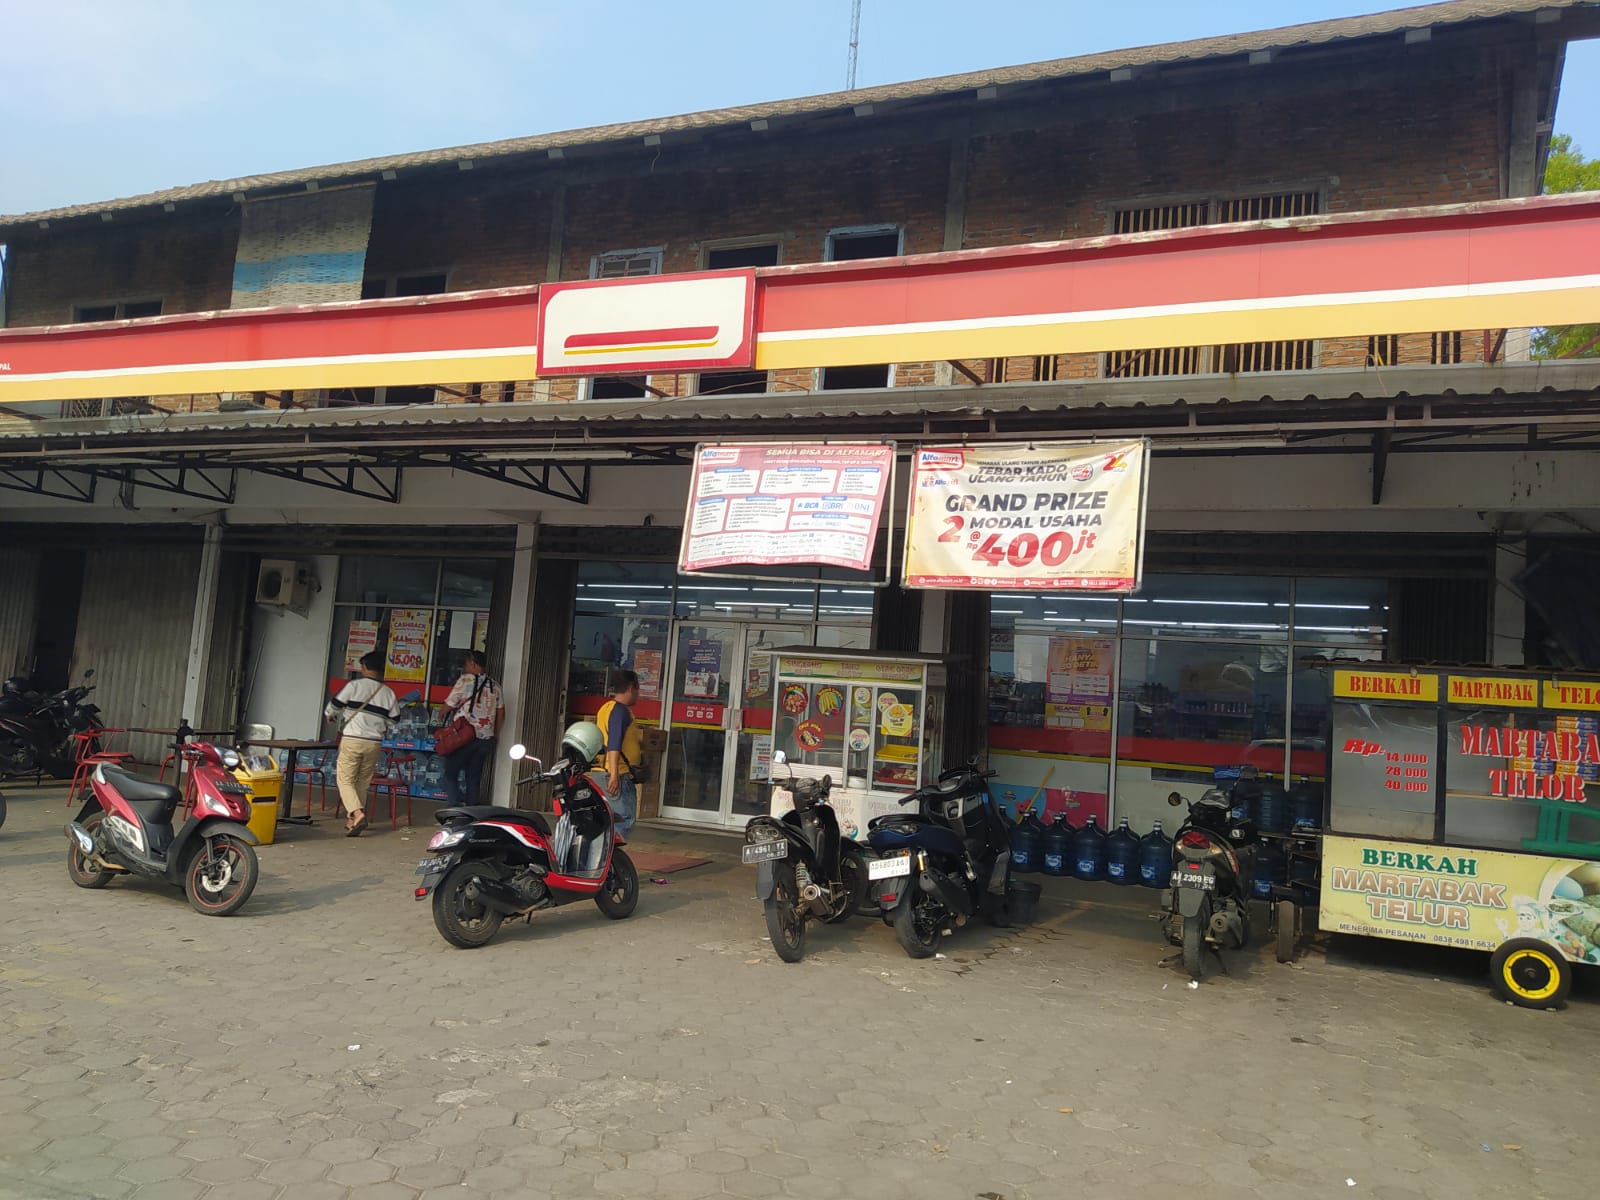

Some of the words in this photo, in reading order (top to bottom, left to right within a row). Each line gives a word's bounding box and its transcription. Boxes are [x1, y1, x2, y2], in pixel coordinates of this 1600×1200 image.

[766, 448, 797, 456] SEMUA
[836, 449, 887, 457] ALFAMART
[968, 474, 1015, 484] ULANG
[1018, 472, 1067, 483] TAHUN
[978, 466, 1022, 475] TEBAR
[1025, 464, 1067, 475] KADO
[945, 494, 1028, 512] GRAND
[1034, 491, 1108, 511] PRIZE
[938, 515, 965, 543] 2
[969, 517, 1034, 529] MODAL
[1039, 514, 1103, 527] USAHA
[971, 531, 1074, 567] 400
[1073, 530, 1097, 555] jt
[1350, 676, 1421, 696] BERKAH
[1452, 681, 1534, 702] MARTABAK
[1487, 767, 1587, 803] TELOR
[1361, 848, 1478, 877] BERKAH
[1183, 873, 1203, 883] 2309
[1332, 867, 1507, 909] MARTABAK
[1366, 895, 1471, 931] TELUR
[1339, 922, 1384, 936] MENERIMA
[1385, 928, 1427, 941] PESANAN
